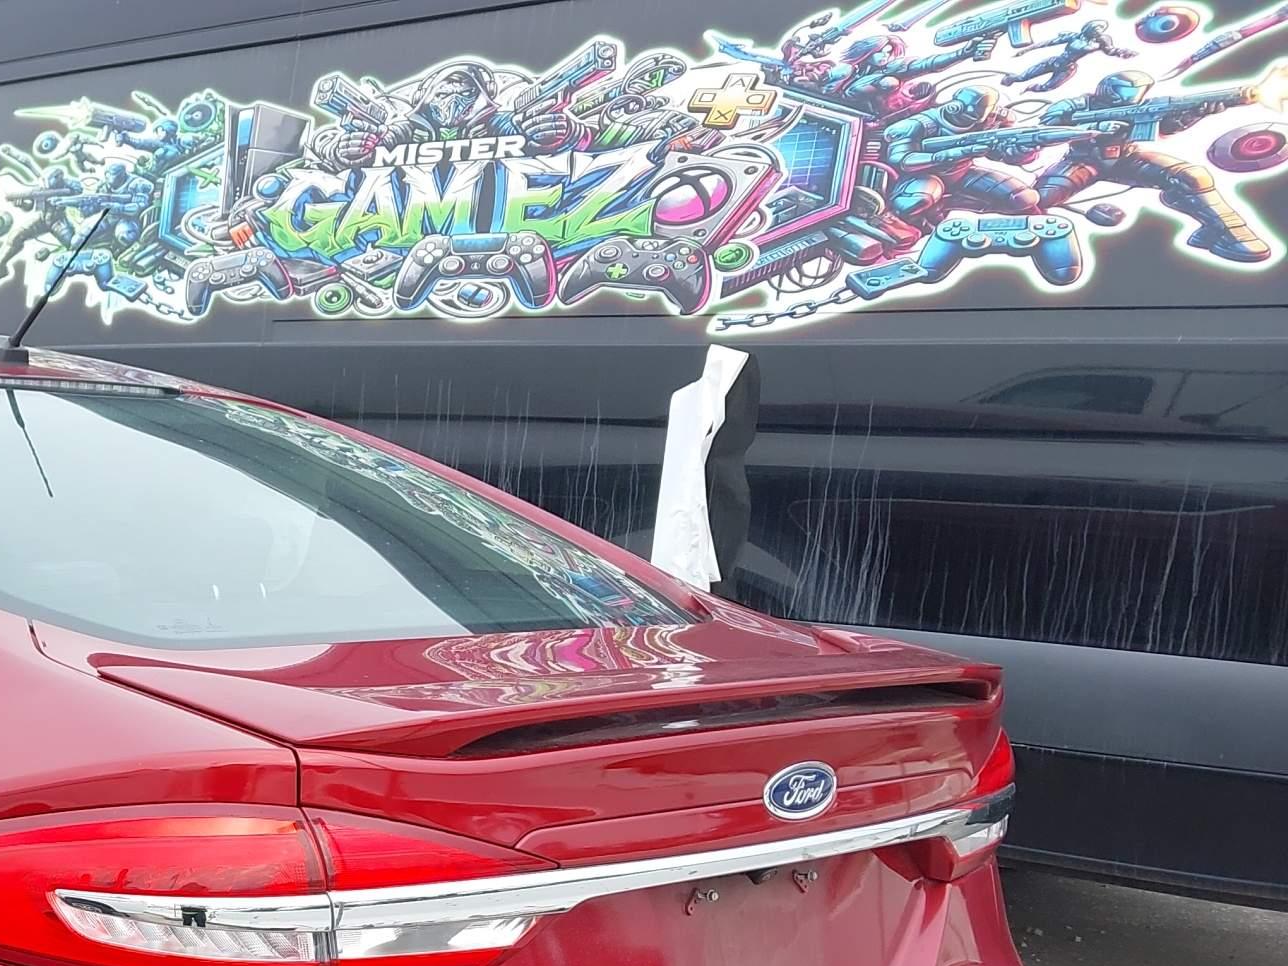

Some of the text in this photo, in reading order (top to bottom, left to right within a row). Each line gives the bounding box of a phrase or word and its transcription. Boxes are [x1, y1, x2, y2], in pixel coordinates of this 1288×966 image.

[372, 134, 527, 168] MISTER
[268, 138, 663, 256] GAMEZ
[782, 773, 825, 807] Ford
